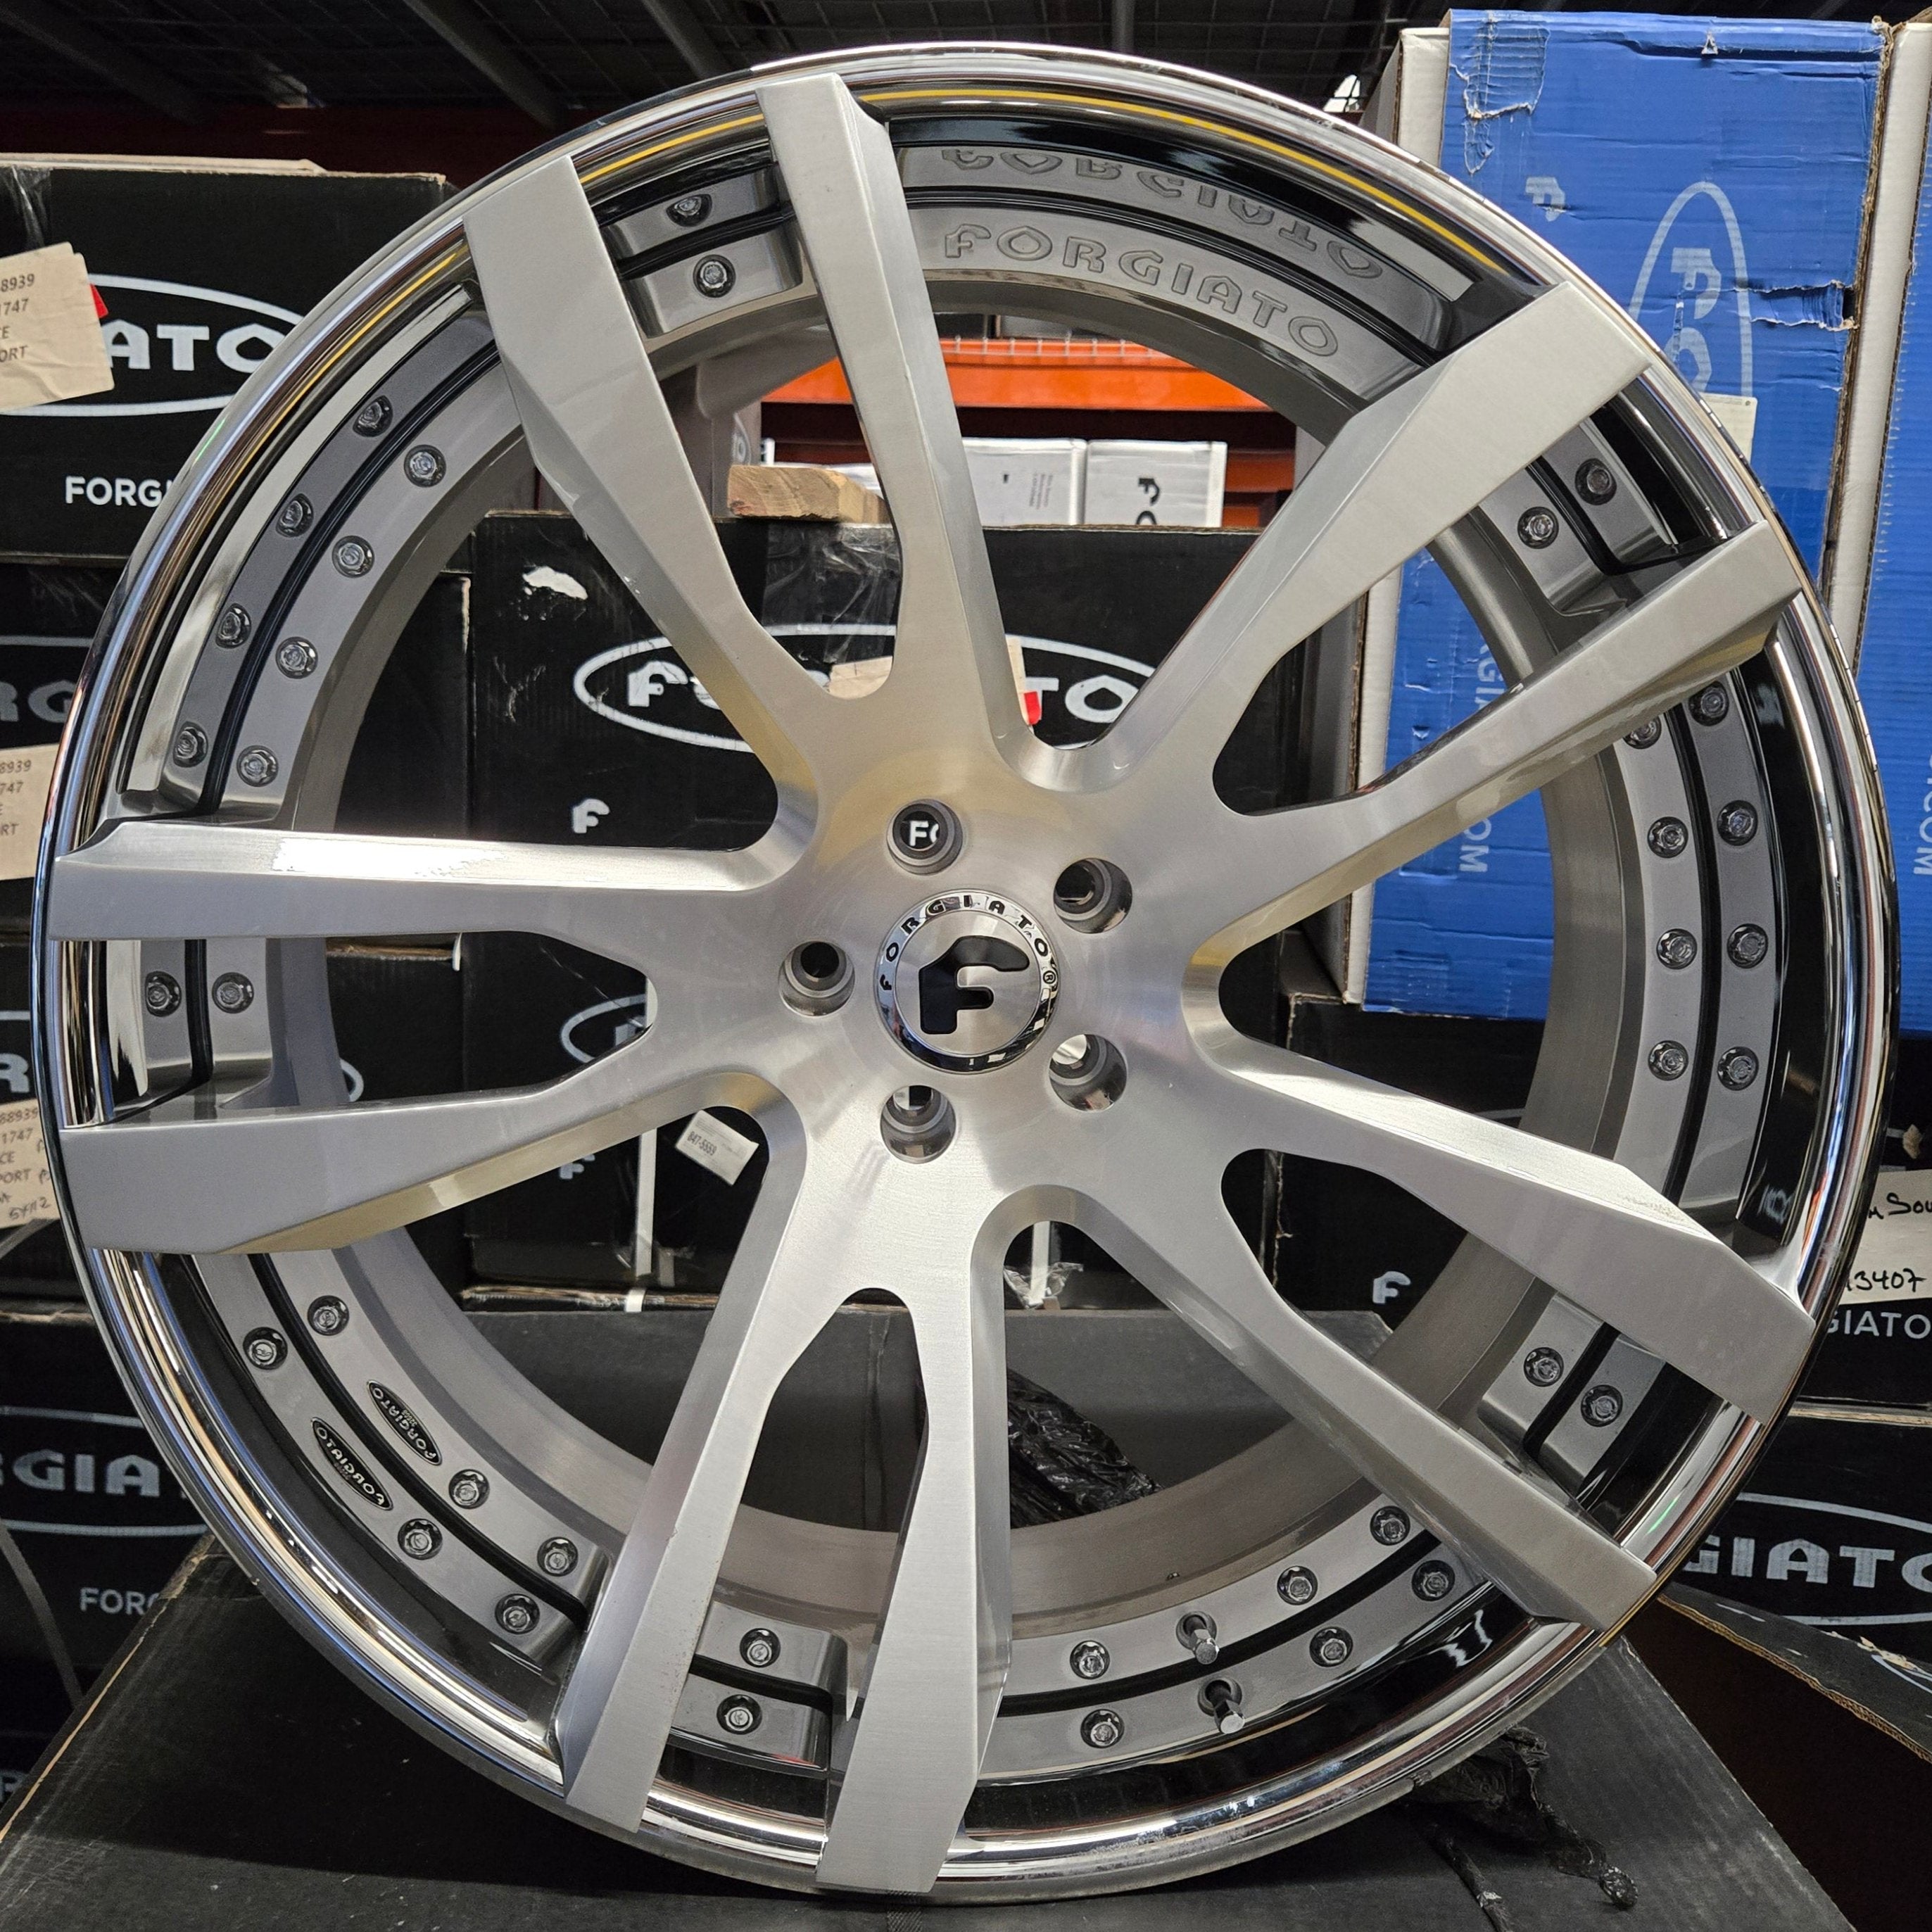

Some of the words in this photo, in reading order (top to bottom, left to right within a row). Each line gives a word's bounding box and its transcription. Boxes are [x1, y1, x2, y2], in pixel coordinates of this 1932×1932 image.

[945, 223, 1339, 357] FORGIATO
[65, 475, 174, 507] FORG
[572, 798, 610, 834] F
[918, 935, 1030, 1035] F
[1372, 1270, 1412, 1304] F
[372, 1387, 438, 1460] FORGIATO
[0, 1448, 188, 1499] GIA
